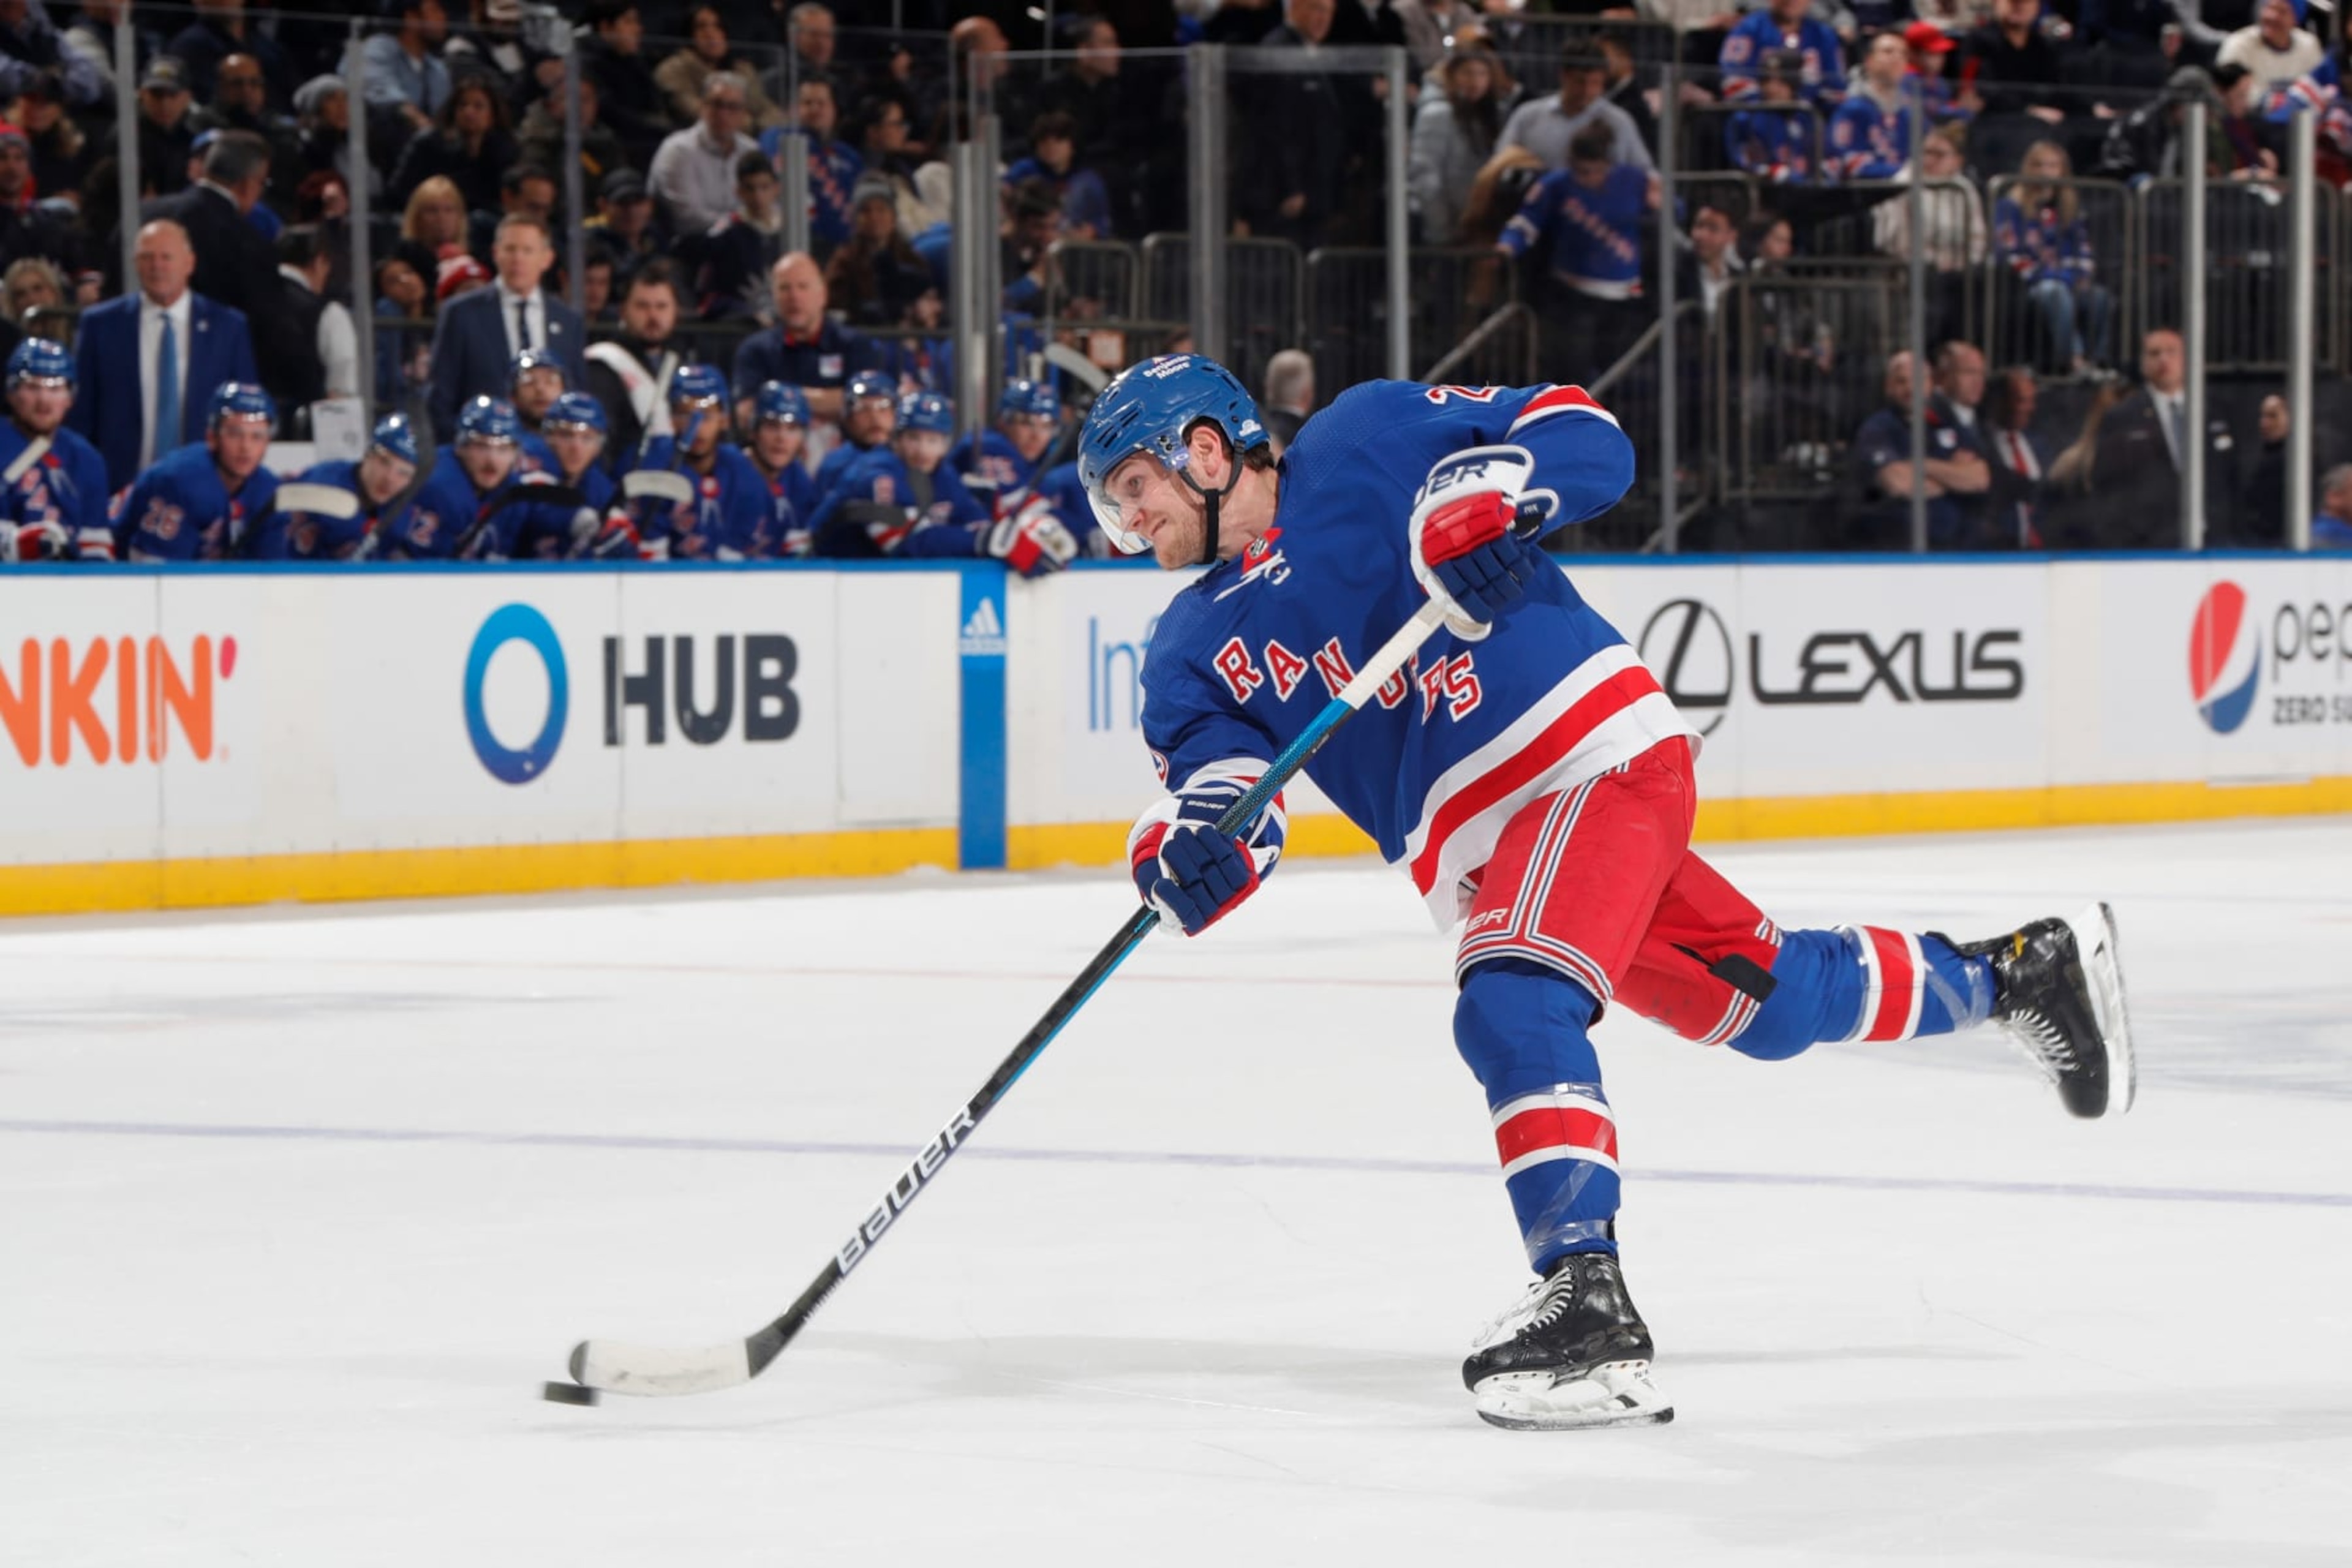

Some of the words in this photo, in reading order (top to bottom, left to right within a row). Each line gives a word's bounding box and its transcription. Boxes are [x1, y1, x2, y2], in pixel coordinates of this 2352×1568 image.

[603, 634, 800, 747] HUB
[1748, 629, 2025, 706] LEXUS
[2273, 695, 2326, 723] ZERO
